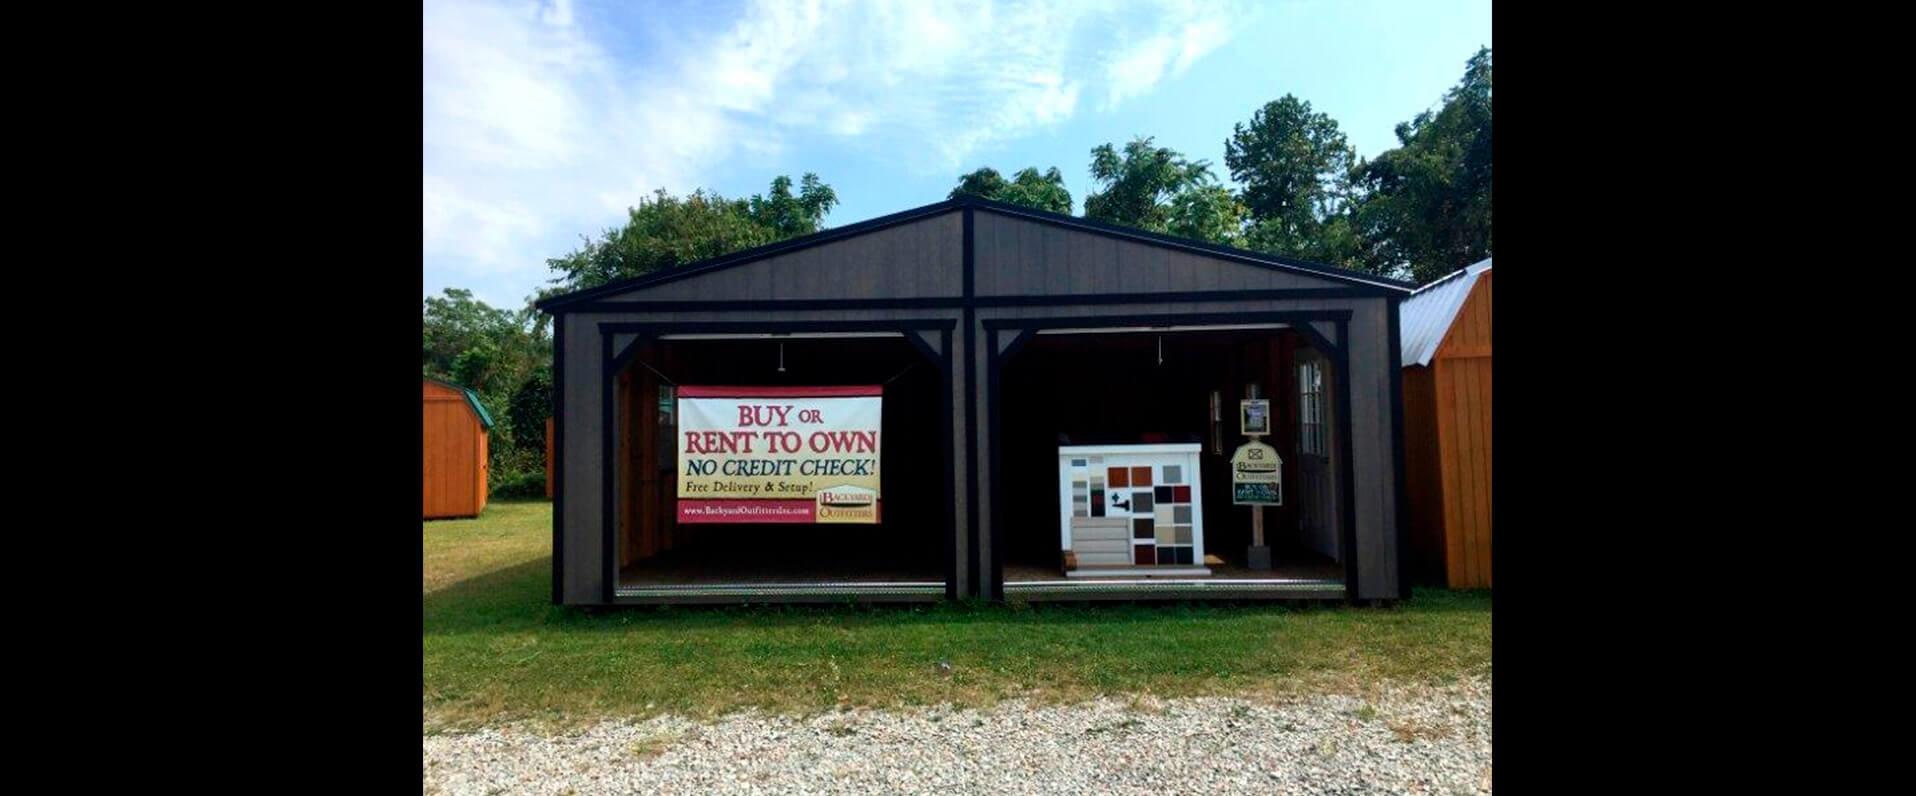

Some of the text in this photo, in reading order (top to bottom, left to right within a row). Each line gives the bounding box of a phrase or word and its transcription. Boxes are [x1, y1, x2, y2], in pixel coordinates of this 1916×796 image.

[738, 405, 824, 427] BUY OR
[684, 430, 877, 454] RENT TO OWN
[686, 459, 876, 477] NO CREDIT CHECK!
[685, 480, 813, 495] Free Delivery & Setup!
